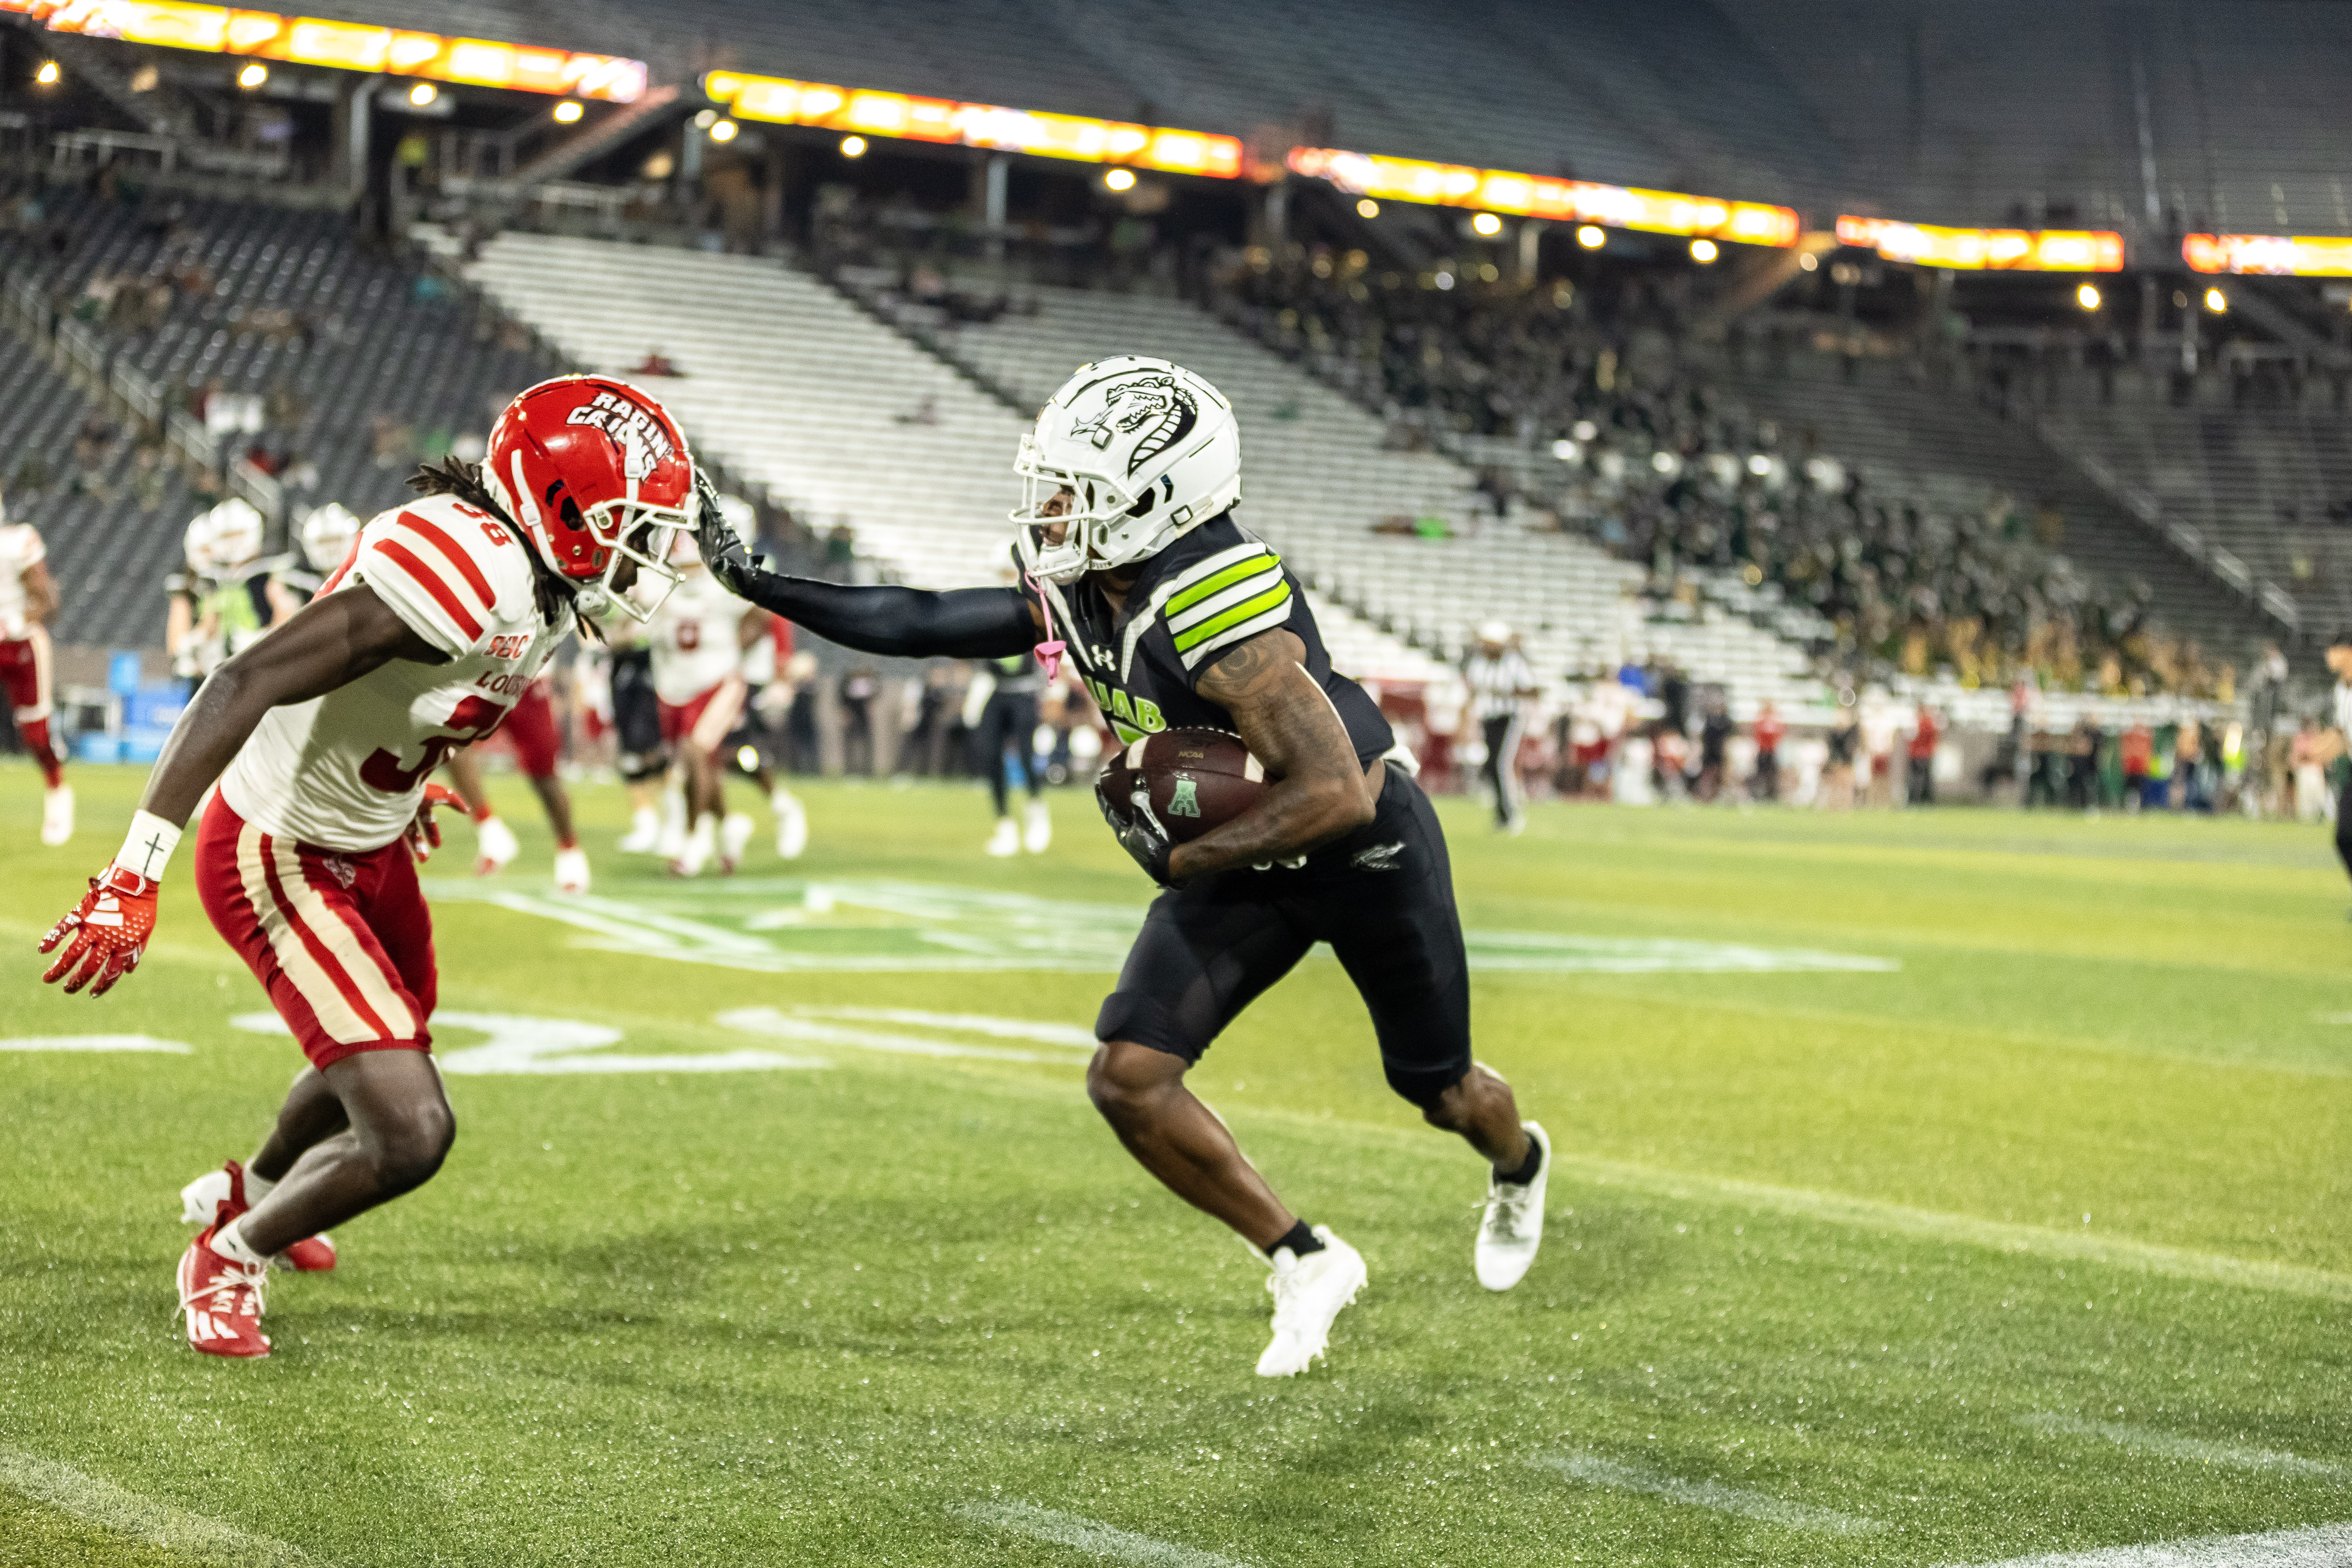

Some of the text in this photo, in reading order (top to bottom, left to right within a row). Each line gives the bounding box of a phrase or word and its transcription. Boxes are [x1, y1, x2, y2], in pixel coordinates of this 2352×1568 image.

[1082, 674, 1167, 733] UAB
[359, 695, 508, 793] 3
[1178, 750, 1204, 760] NCAA
